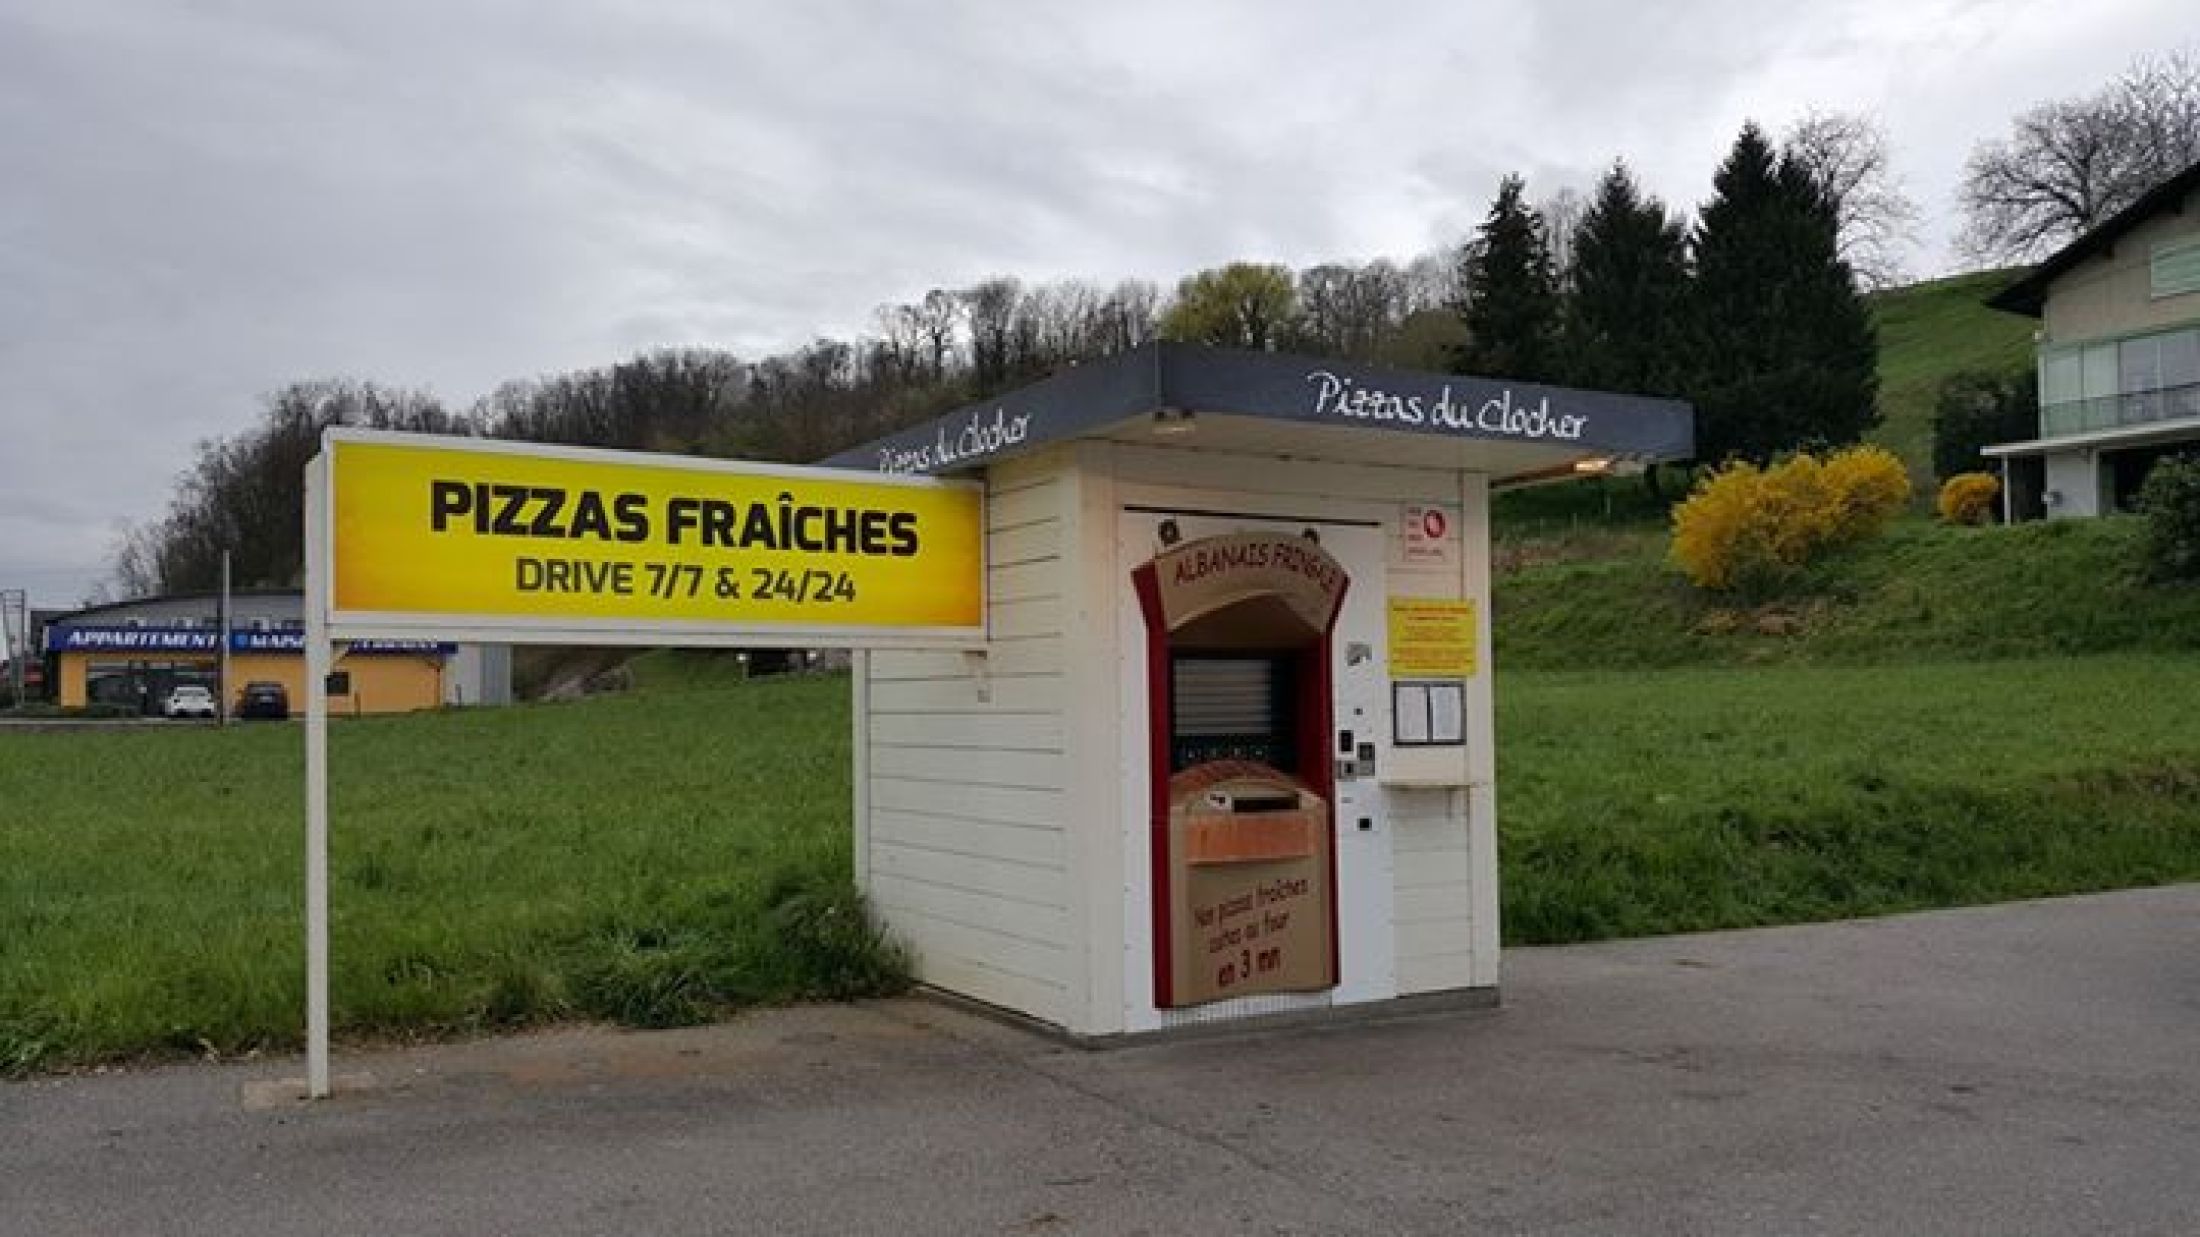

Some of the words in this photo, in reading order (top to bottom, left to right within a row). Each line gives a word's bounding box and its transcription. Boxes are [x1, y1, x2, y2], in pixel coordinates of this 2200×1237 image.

[1306, 369, 1425, 424] Pizzas
[1432, 384, 1474, 429] du
[1478, 389, 1590, 438] Clocher
[430, 480, 650, 543] PIZZAS
[666, 492, 918, 557] FRAÎCHES
[515, 557, 634, 594] DRIVE
[644, 562, 704, 600] 7/7
[714, 567, 740, 599] &
[751, 567, 857, 603] 24/24
[1218, 961, 1236, 988] en
[1240, 949, 1251, 979] 3
